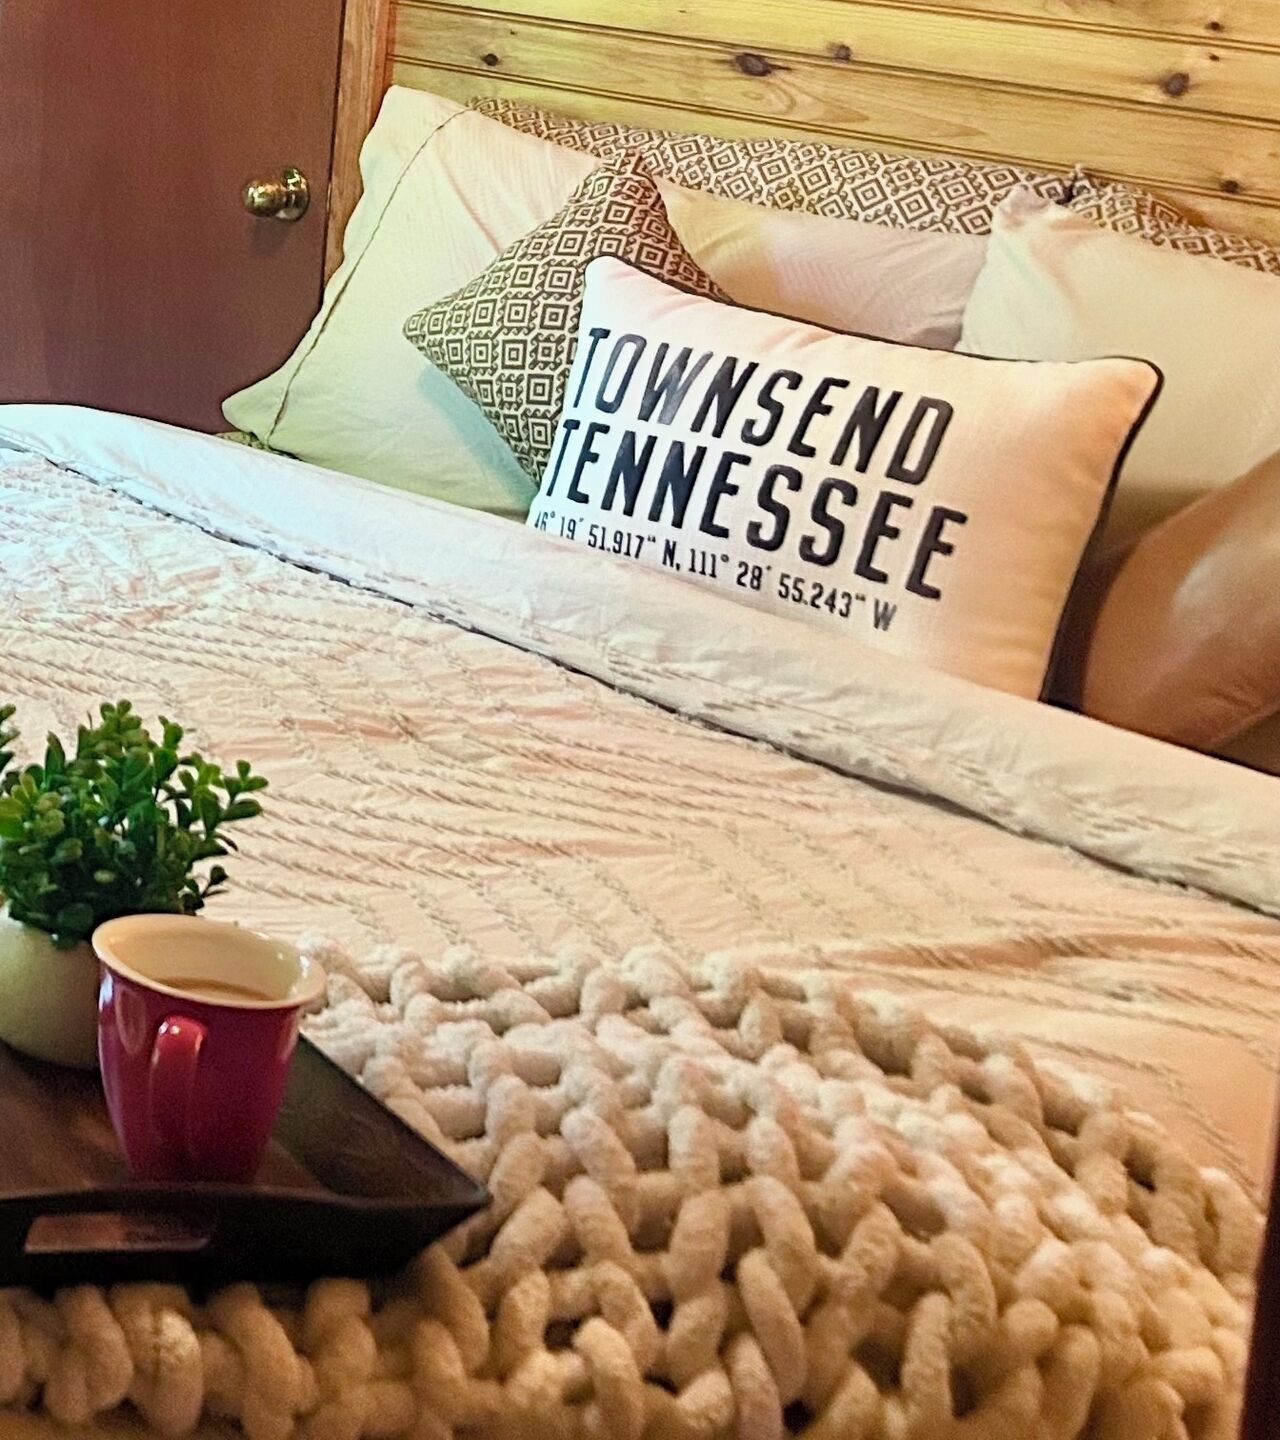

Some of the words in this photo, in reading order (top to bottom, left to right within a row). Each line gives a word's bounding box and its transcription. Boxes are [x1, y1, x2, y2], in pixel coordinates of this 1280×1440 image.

[573, 327, 954, 486] TOWNSEND
[546, 419, 968, 600] TENNESSEE
[662, 538, 681, 571] N,
[873, 597, 897, 632] W
